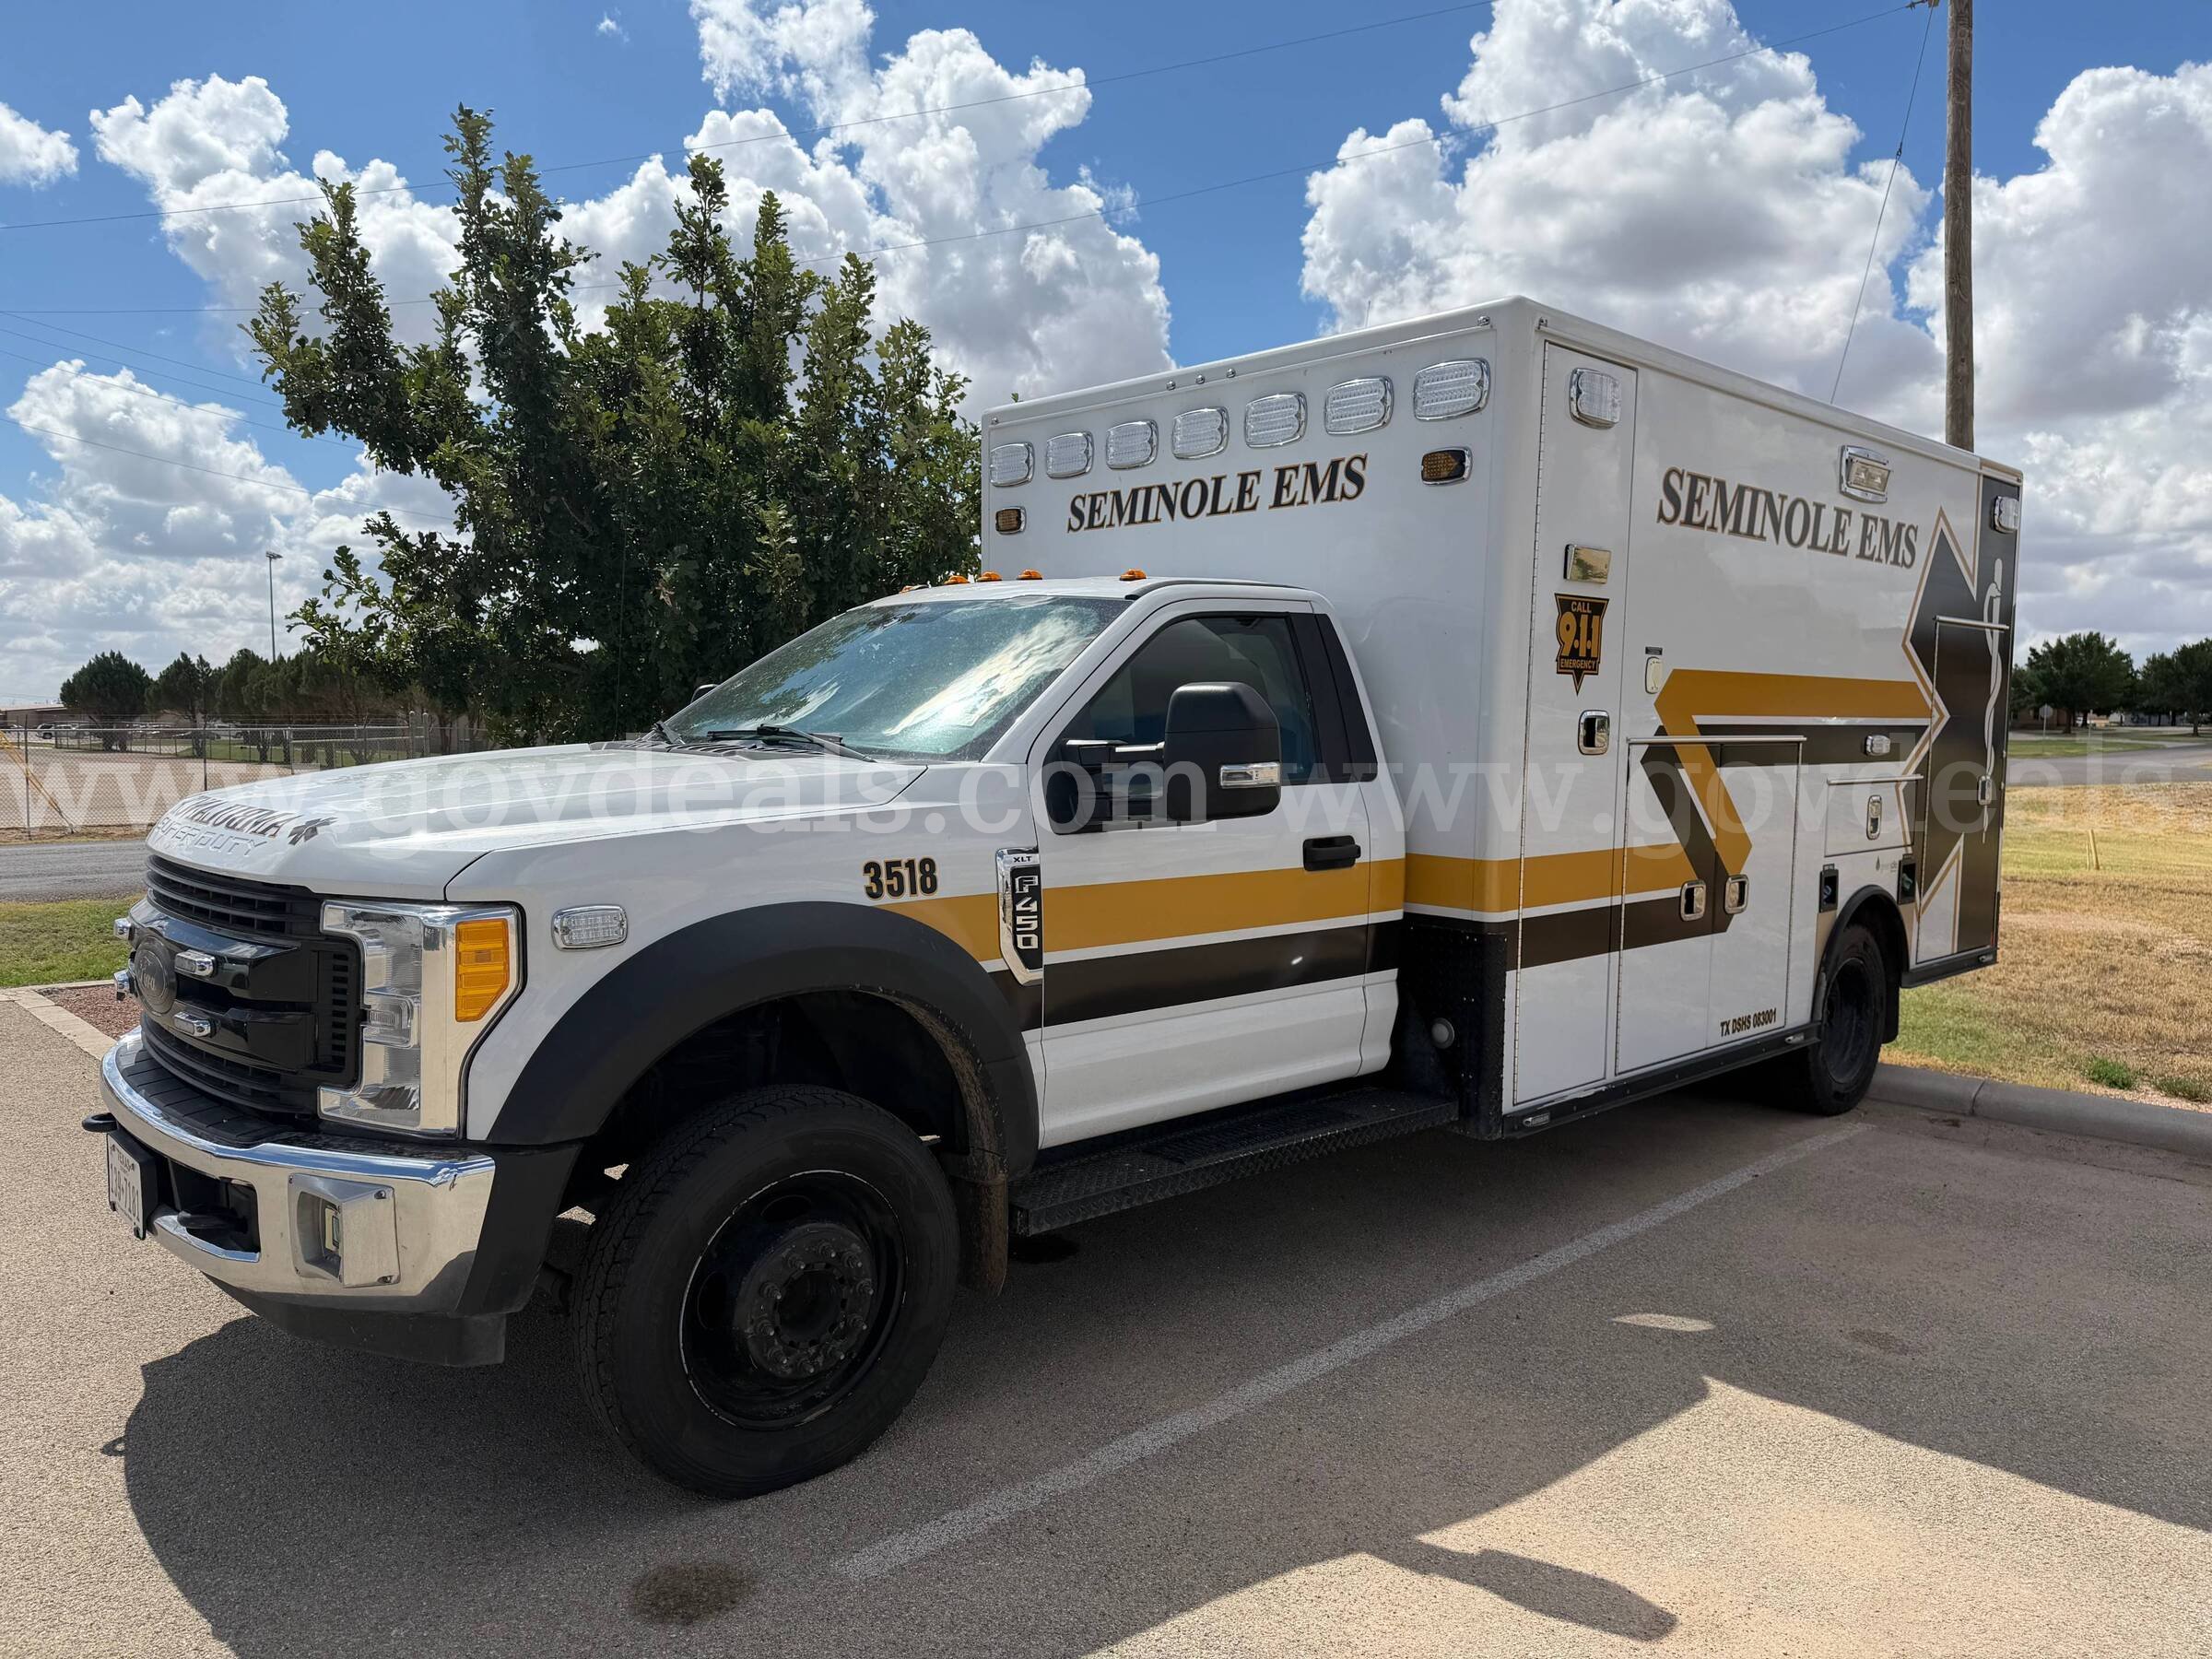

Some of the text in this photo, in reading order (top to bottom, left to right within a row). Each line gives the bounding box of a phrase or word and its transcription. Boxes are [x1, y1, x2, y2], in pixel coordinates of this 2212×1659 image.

[1066, 453, 1369, 534] SEMINOLE EMS
[1657, 465, 1919, 570] SEMINOLE EMS
[1571, 601, 1592, 613] CALL
[1560, 658, 1596, 670] EMERGENCY
[194, 830, 267, 856] DUTY
[863, 856, 938, 900] 3518
[1720, 1018, 1731, 1037] TX
[1732, 1014, 1751, 1034] DSHS
